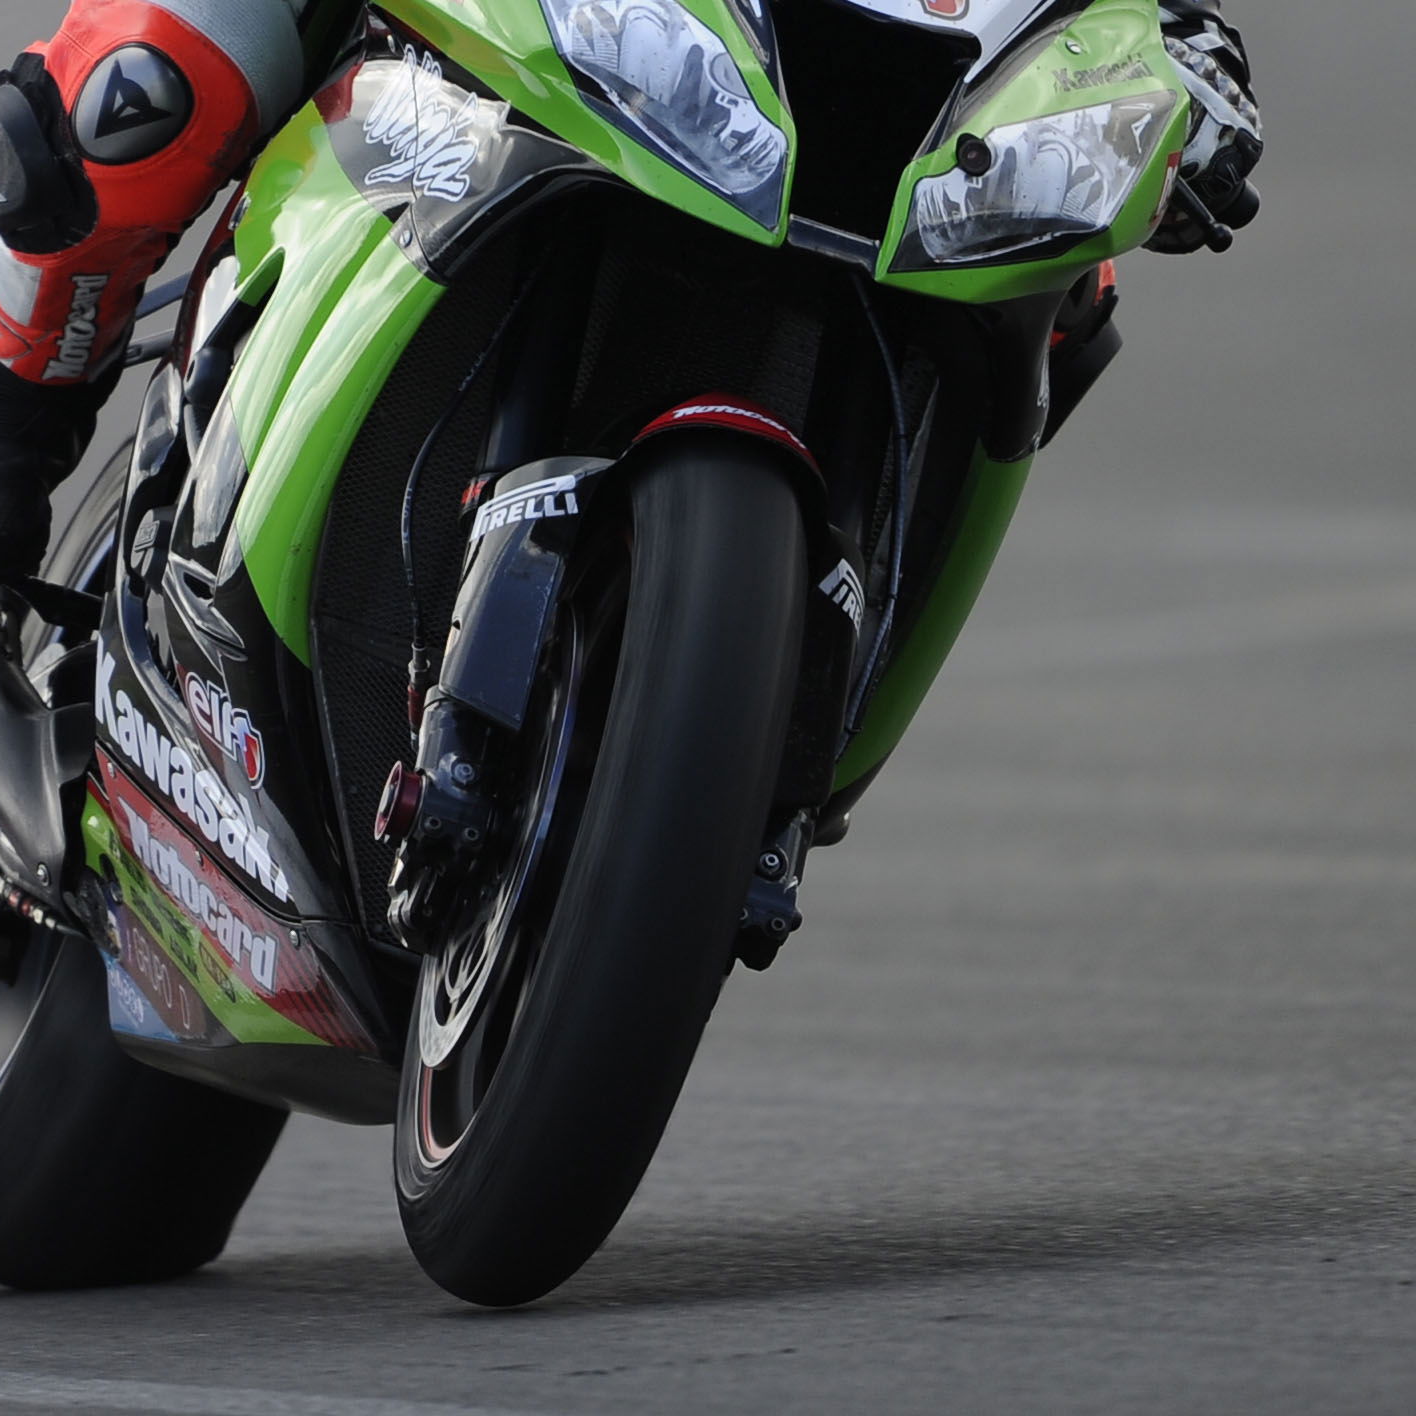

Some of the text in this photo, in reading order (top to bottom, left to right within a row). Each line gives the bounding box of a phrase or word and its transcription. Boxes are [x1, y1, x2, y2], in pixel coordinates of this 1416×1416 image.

[469, 474, 579, 542] PIRELLI
[818, 558, 865, 640] PIRE
[185, 672, 244, 761] elf
[95, 631, 288, 903] Kawasaki
[118, 796, 279, 994] Motocard
